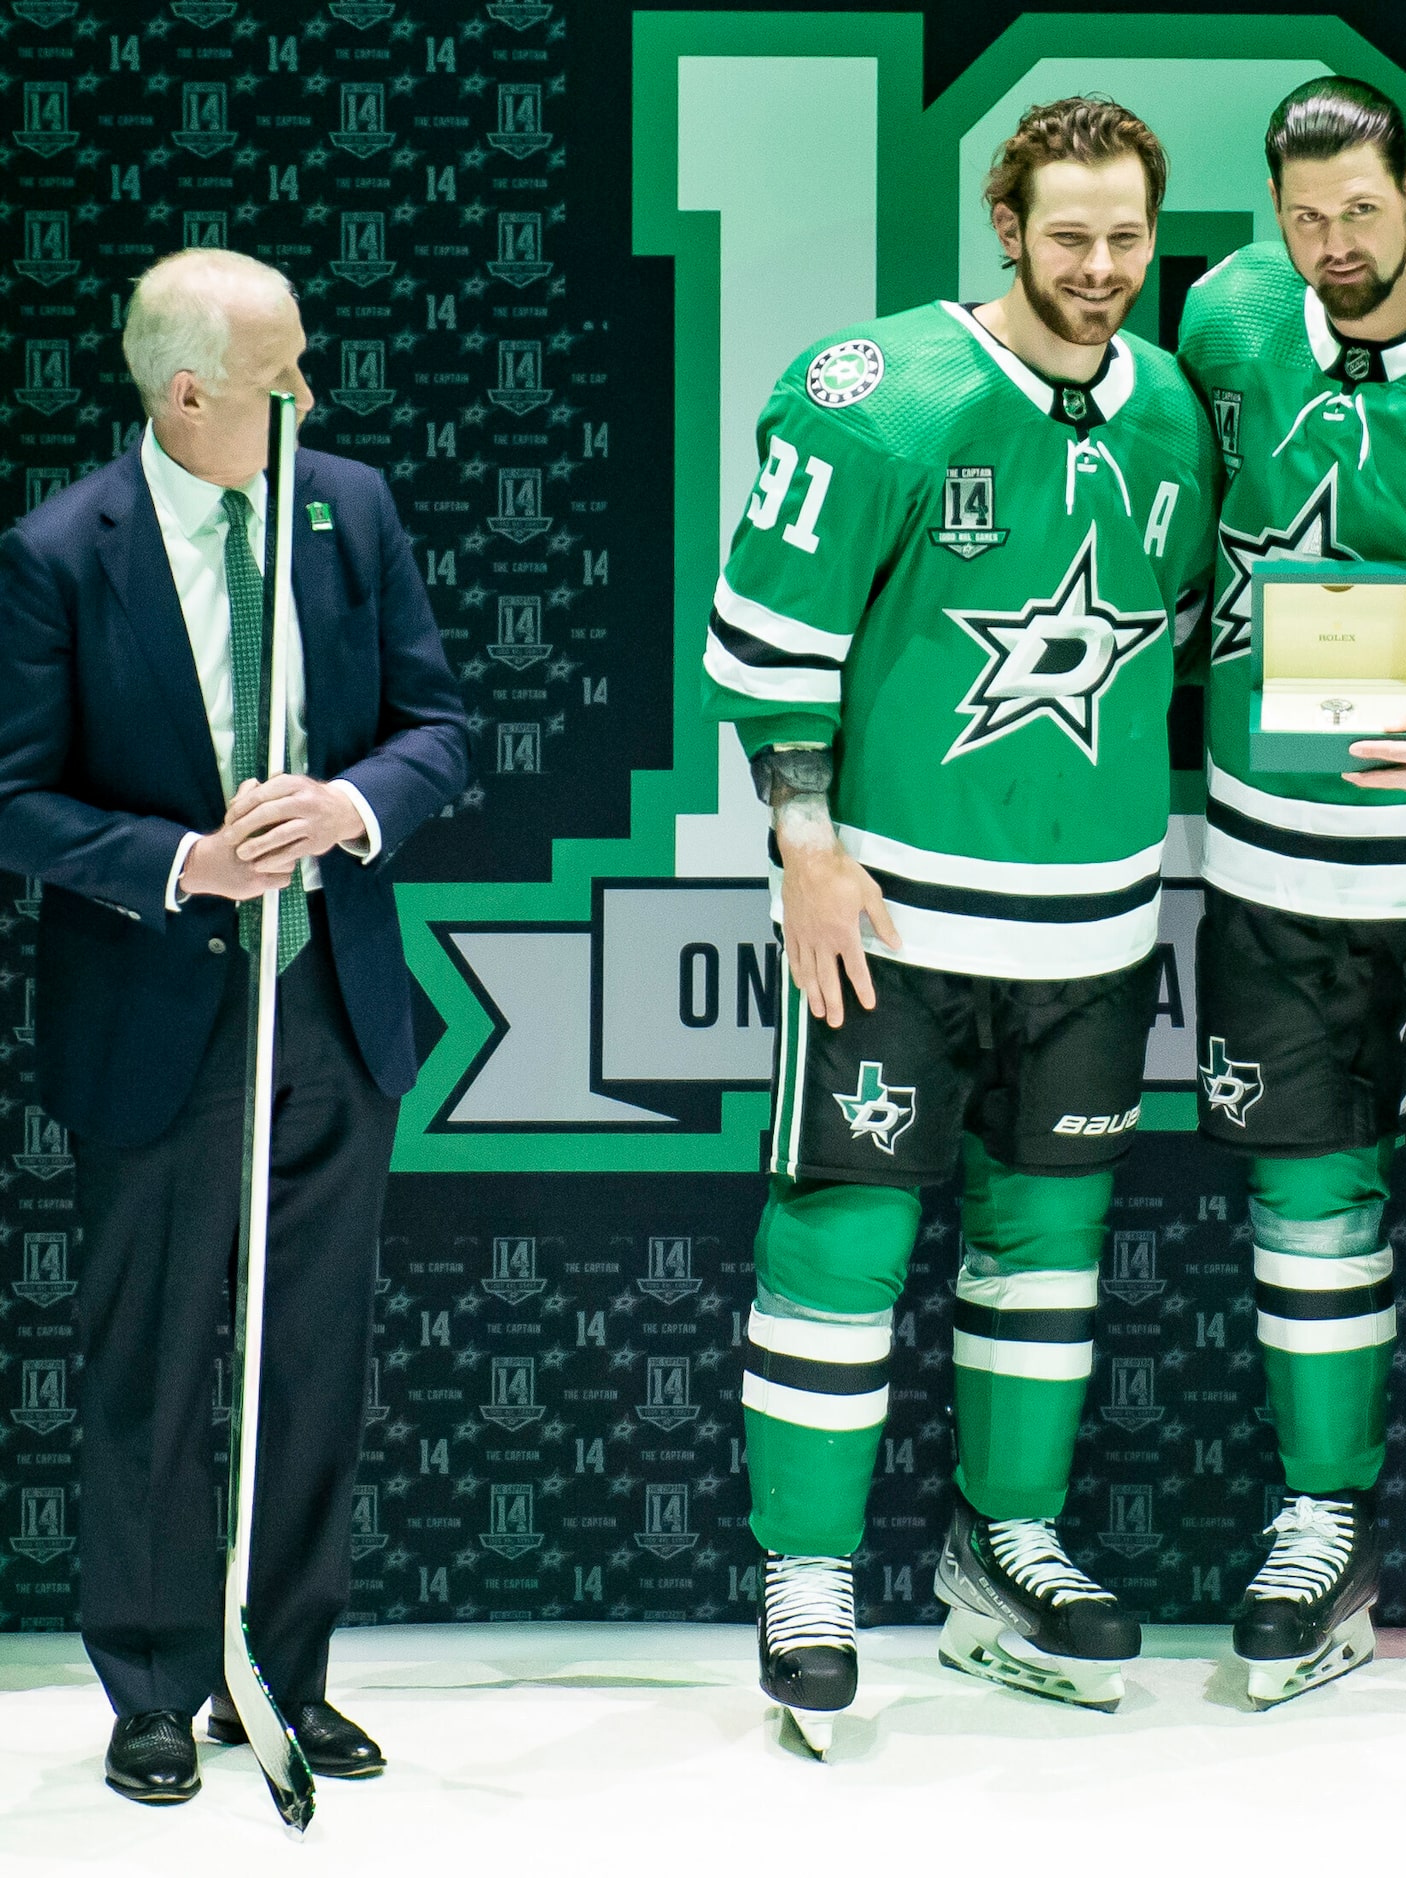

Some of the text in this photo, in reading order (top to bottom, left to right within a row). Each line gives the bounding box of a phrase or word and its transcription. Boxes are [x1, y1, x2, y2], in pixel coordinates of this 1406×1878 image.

[111, 35, 139, 70] 14
[269, 36, 297, 71] 14
[427, 37, 455, 72] 14
[189, 93, 218, 130] 14
[347, 94, 376, 131] 14
[504, 95, 533, 132] 14
[112, 165, 140, 200] 14
[270, 165, 298, 200] 14
[426, 166, 456, 201] 14
[31, 222, 60, 259] 14
[426, 294, 456, 329] 14
[32, 350, 61, 387] 14
[347, 351, 378, 388] 14
[504, 351, 535, 388] 14
[426, 422, 456, 457] 14
[947, 468, 992, 477] THE CAPTAIN
[414, 501, 469, 511] THE CAPTAIN
[504, 479, 535, 516] 14
[746, 434, 834, 554] 91
[950, 481, 989, 526] 14
[1143, 480, 1180, 558] A
[426, 549, 456, 585] 14
[504, 606, 533, 643] 14
[1319, 633, 1356, 642] ROLEX
[504, 734, 534, 771] 14
[680, 942, 776, 1028] ON
[1052, 1104, 1140, 1135] BAUE
[29, 1243, 60, 1280] 14
[408, 1263, 463, 1273] THE CAPTAIN
[499, 1241, 530, 1278] 14
[564, 1263, 619, 1273] THE CAPTAIN
[655, 1241, 686, 1278] 14
[1119, 1242, 1150, 1279] 14
[1184, 1264, 1239, 1274] THE CAPTAIN
[420, 1311, 450, 1346] 14
[486, 1324, 541, 1334] THE CAPTAIN
[576, 1311, 606, 1346] 14
[641, 1324, 696, 1334] THE CAPTAIN
[1106, 1325, 1161, 1335] THE CAPTAIN
[1197, 1312, 1225, 1347] 14
[28, 1370, 59, 1407] 14
[497, 1367, 528, 1404] 14
[563, 1390, 618, 1400] THE CAPTAIN
[1117, 1368, 1148, 1405] 14
[1182, 1392, 1237, 1402] THE CAPTAIN
[419, 1438, 449, 1474] 14
[576, 1438, 604, 1473] 14
[640, 1451, 695, 1461] THE CAPTAIN
[886, 1438, 914, 1473] 14
[1195, 1439, 1223, 1474] 14
[406, 1518, 461, 1528] THE CAPTAIN
[561, 1518, 616, 1528] THE CAPTAIN
[651, 1495, 682, 1532] 14
[420, 1566, 448, 1601] 14
[573, 1566, 603, 1601] 14
[884, 1566, 912, 1601] 14
[978, 1575, 1020, 1624] BAUER
[1191, 1565, 1221, 1601] 14
